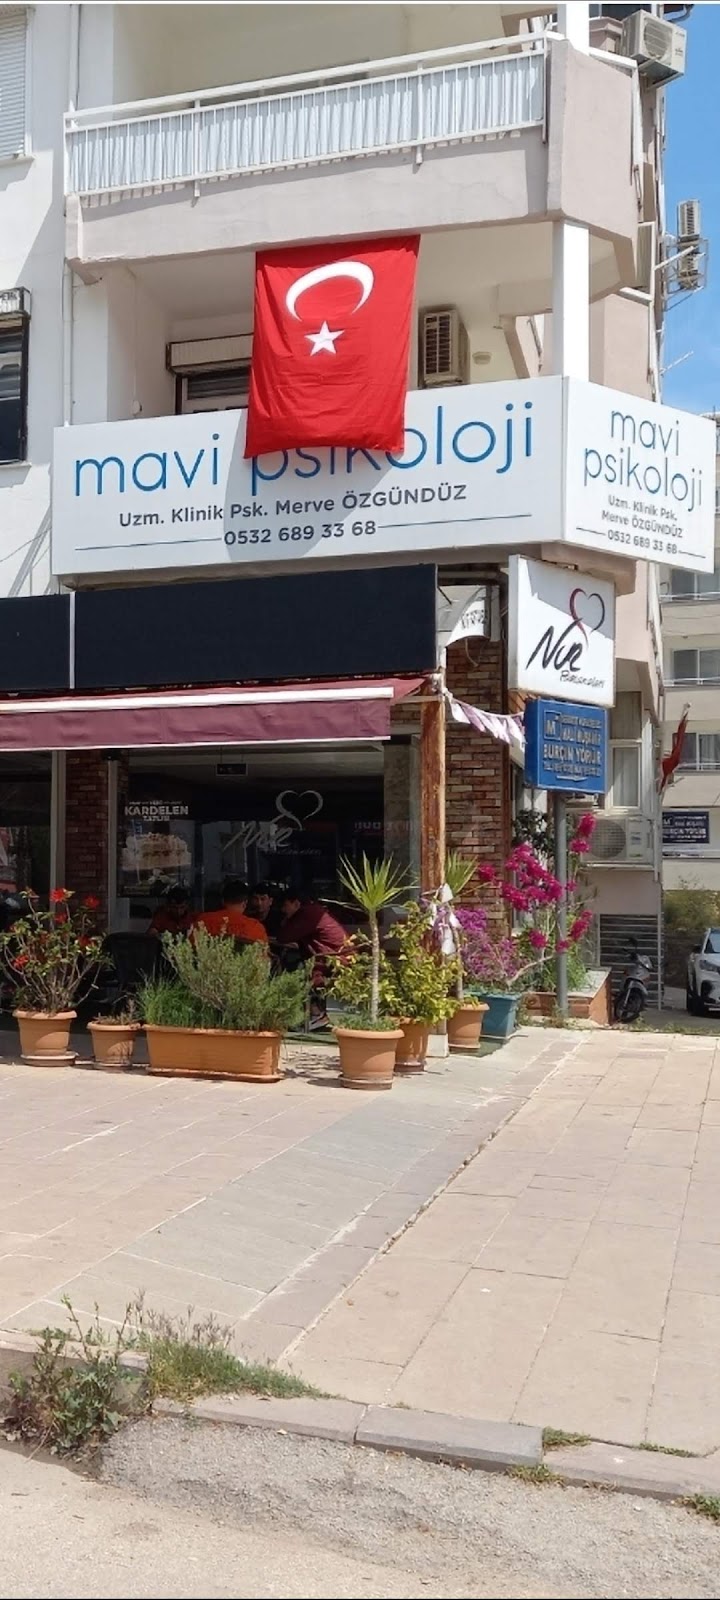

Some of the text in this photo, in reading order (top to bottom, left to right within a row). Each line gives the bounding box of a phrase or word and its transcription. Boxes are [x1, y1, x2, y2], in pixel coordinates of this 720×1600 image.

[611, 410, 680, 456] mavi
[75, 433, 219, 496] mavi
[584, 447, 702, 511] psikoloji
[119, 482, 467, 527] Uzm. Klinik Psk. Merve ÖZGÜNDÜZ
[608, 495, 631, 509] Uzm.
[633, 501, 659, 516] Klinik
[602, 510, 629, 525] Merve
[224, 521, 376, 545] 0532 689 33 68
[608, 530, 631, 544] 0532
[633, 536, 650, 549] 689
[124, 805, 189, 816] KARDELEN
